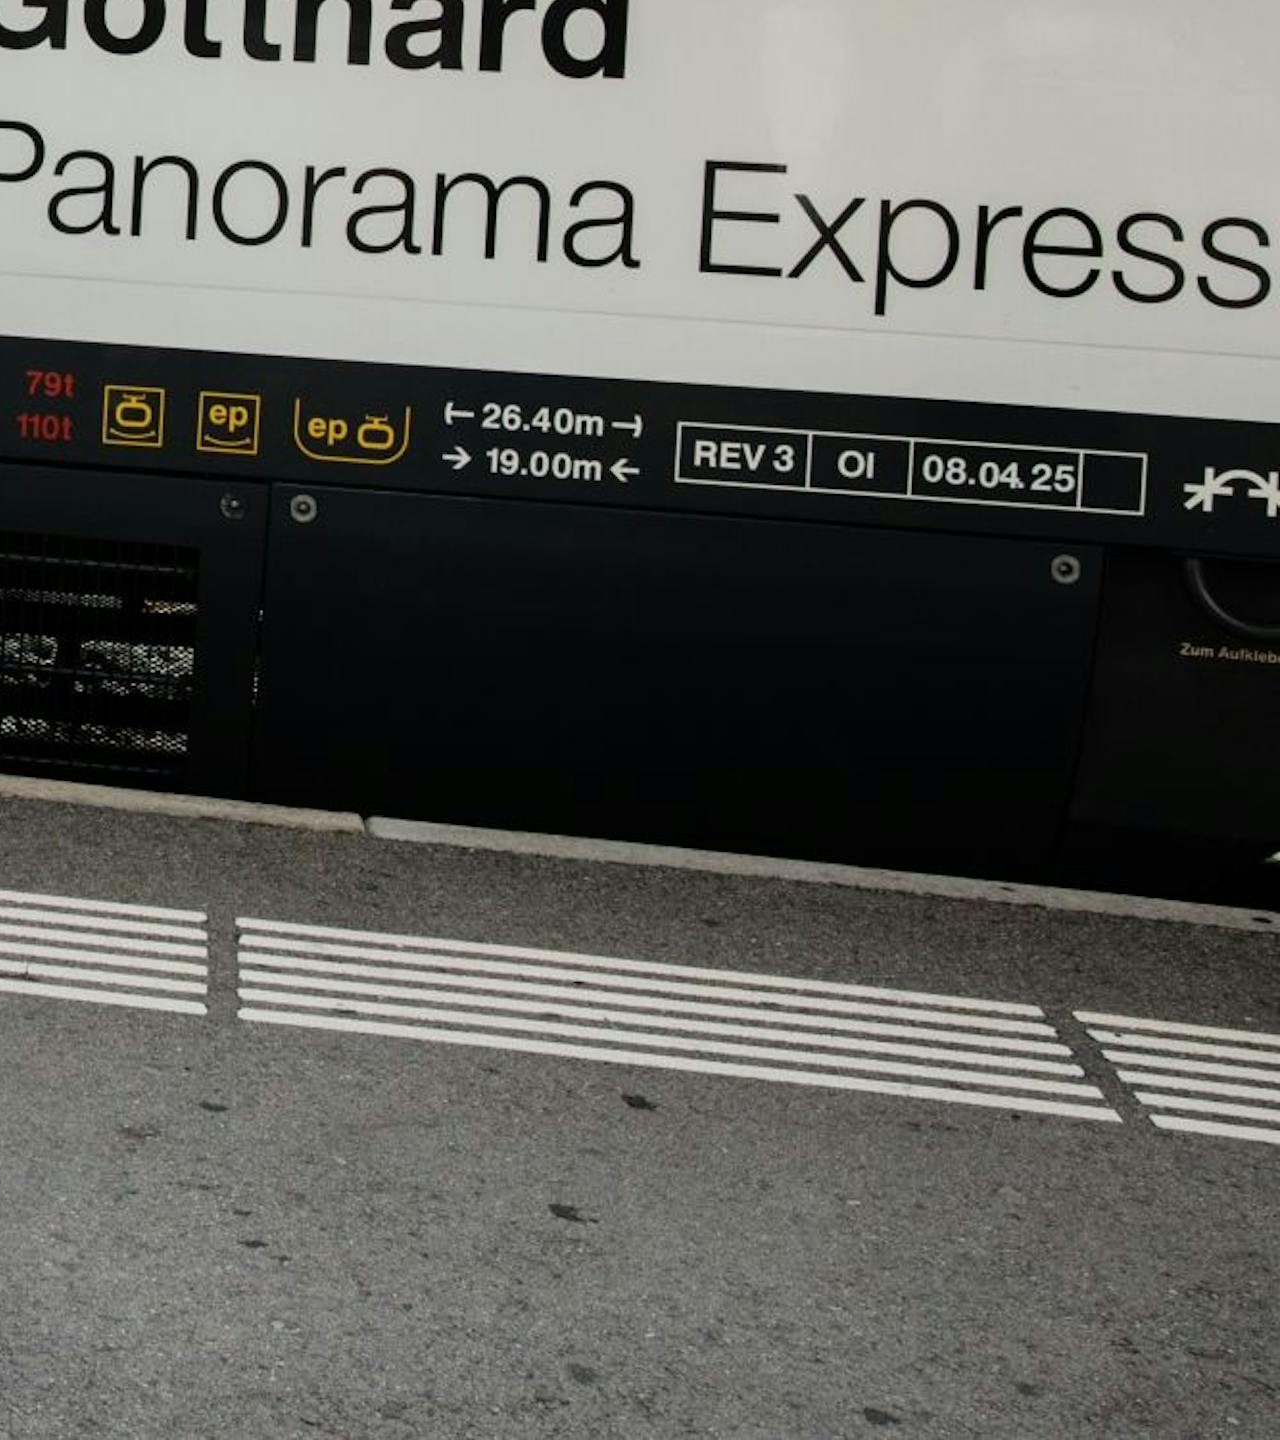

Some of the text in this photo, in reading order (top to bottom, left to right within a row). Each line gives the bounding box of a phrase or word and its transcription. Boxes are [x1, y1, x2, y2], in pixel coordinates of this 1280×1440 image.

[696, 160, 1274, 316] Express
[25, 370, 75, 398] 79t
[16, 412, 73, 442] 110t
[208, 403, 249, 433] ep
[307, 414, 348, 446] ep
[481, 402, 604, 437] 26.40m
[485, 447, 602, 481] 19.00m
[693, 440, 795, 473] REV 3
[1179, 642, 1214, 658] Zum
